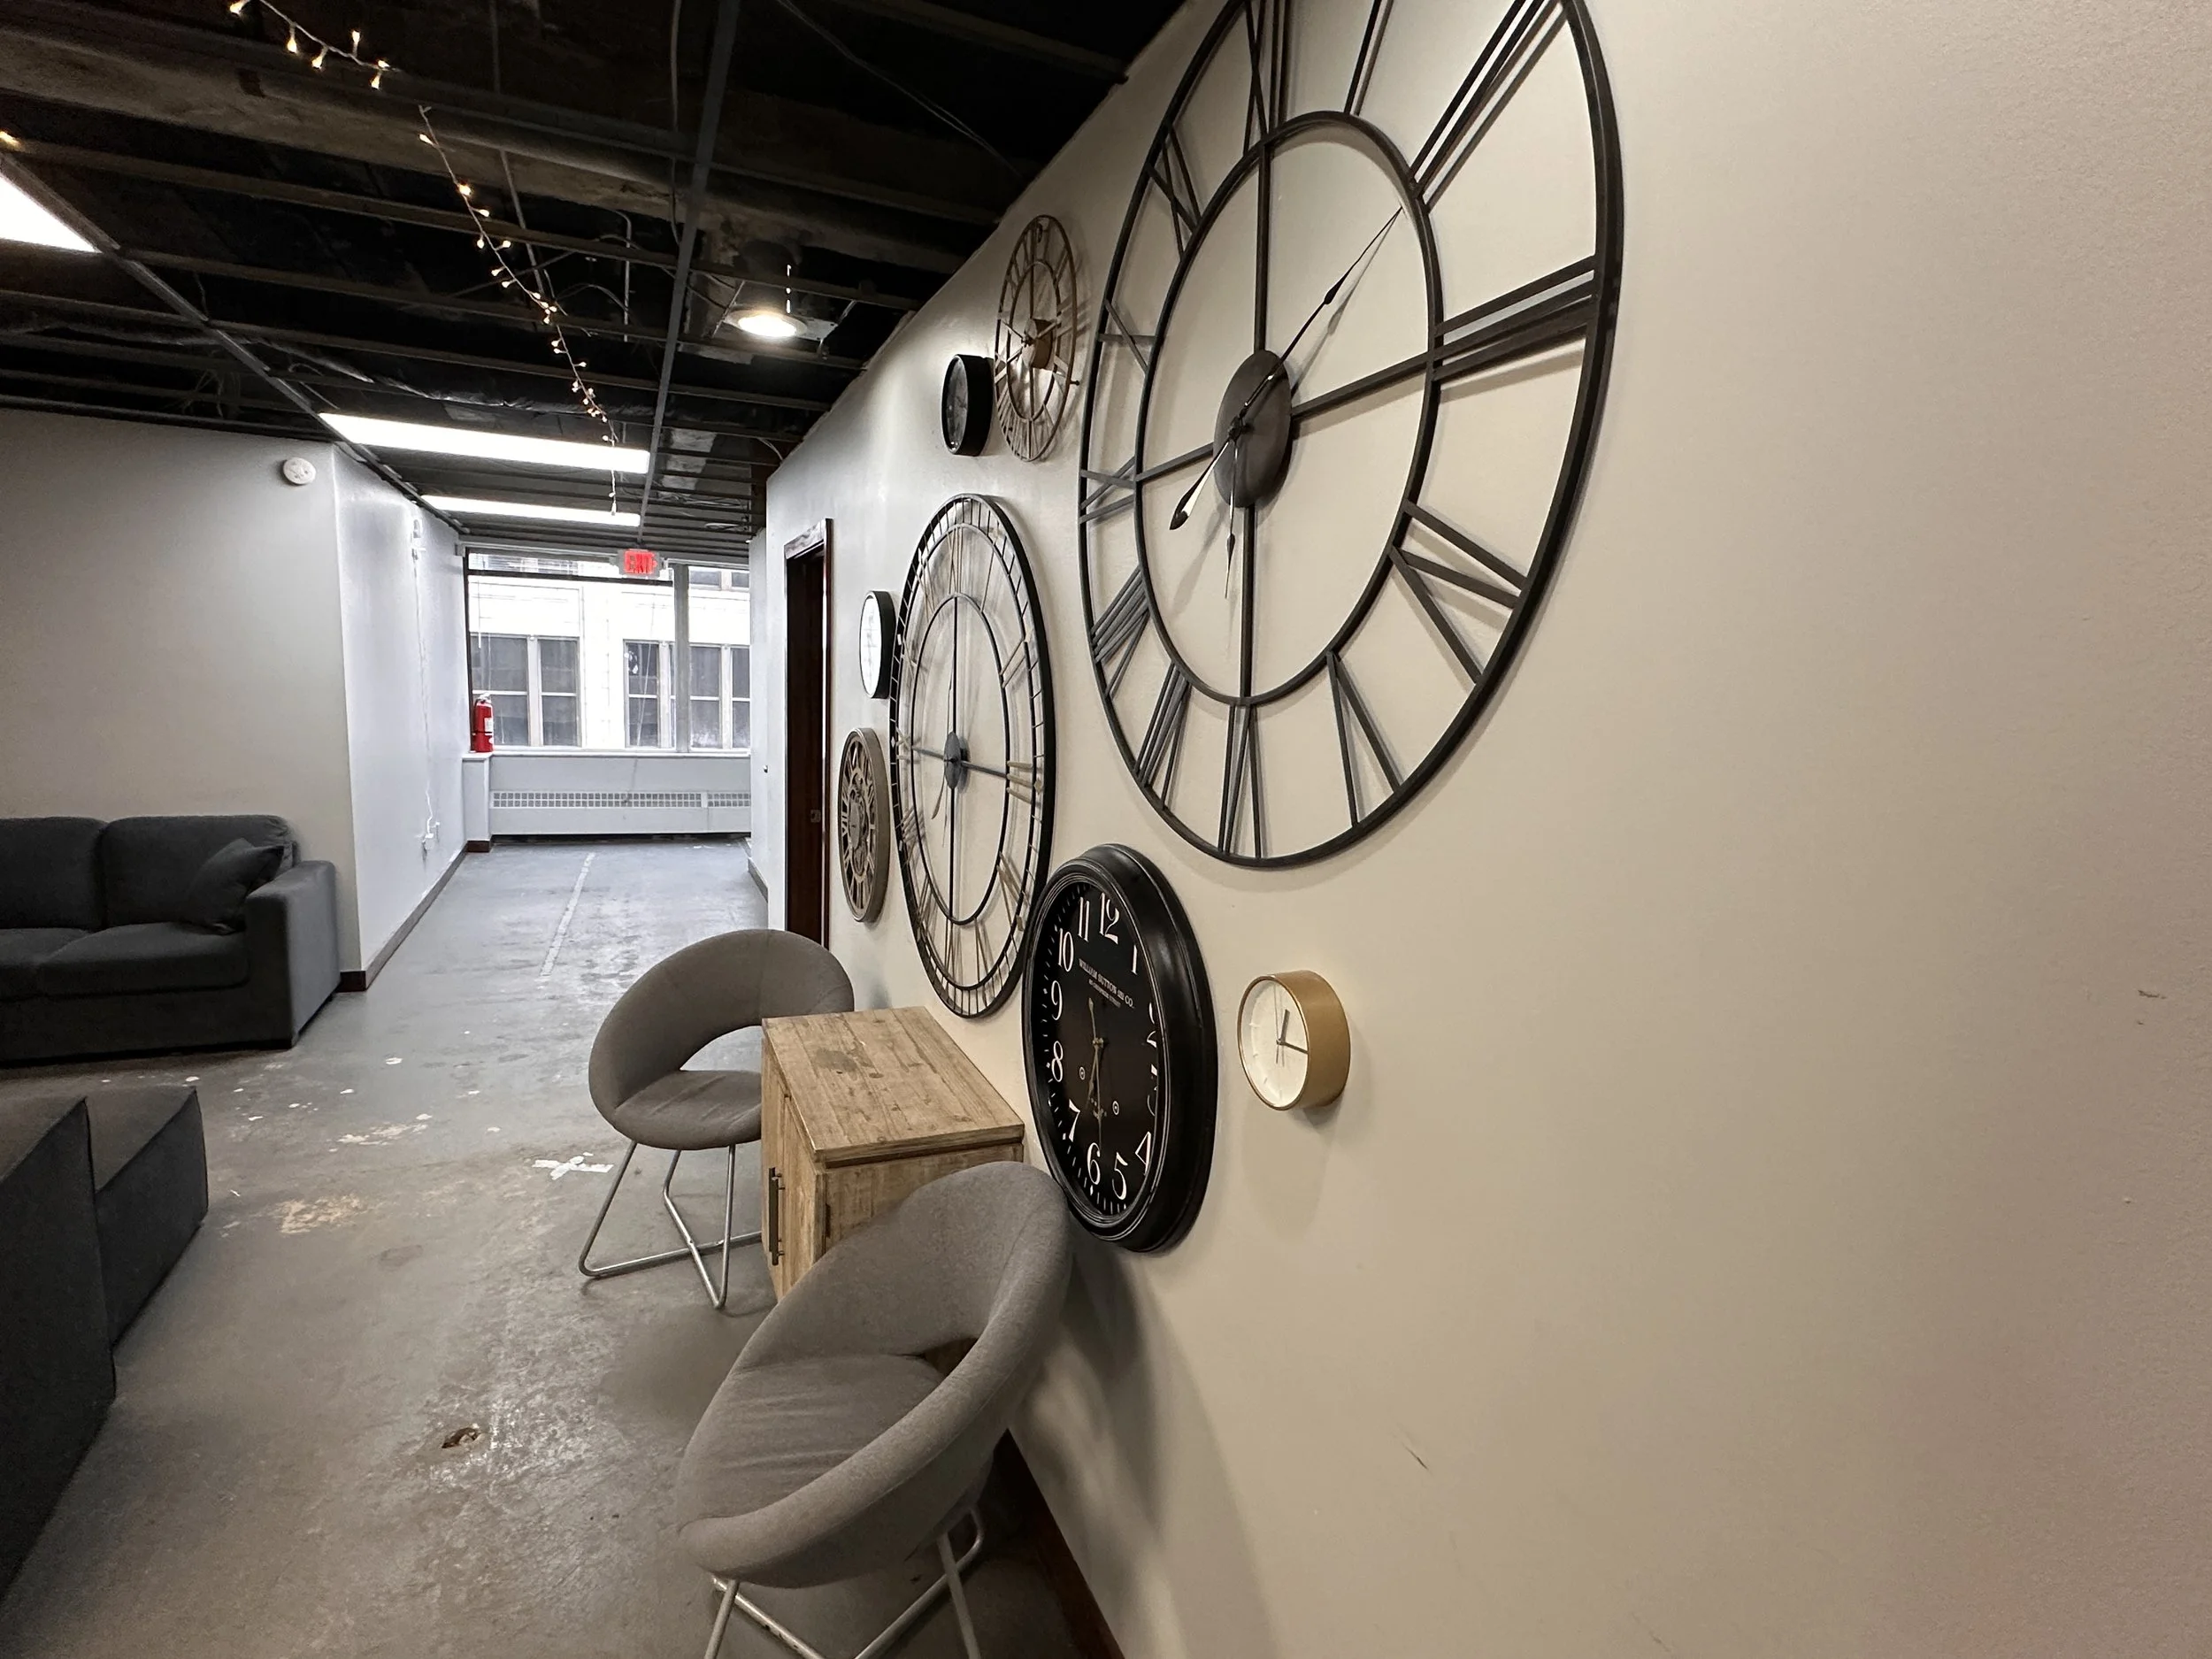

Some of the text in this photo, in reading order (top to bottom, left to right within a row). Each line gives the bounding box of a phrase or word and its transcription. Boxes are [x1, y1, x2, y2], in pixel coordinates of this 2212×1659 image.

[625, 550, 653, 574] EXIT
[1077, 896, 1090, 942] 11
[1099, 892, 1120, 945] 12
[1057, 927, 1075, 972] 10
[1132, 944, 1138, 975] 1
[1079, 957, 1098, 980] WILLIAM
[1097, 973, 1118, 995] SUTTON
[1050, 979, 1063, 1021] 9
[1051, 1040, 1064, 1083] 8
[1068, 1098, 1081, 1143] 7
[1087, 1141, 1102, 1186] 6
[1111, 1151, 1129, 1201] 5
[1134, 1131, 1152, 1176] 4
